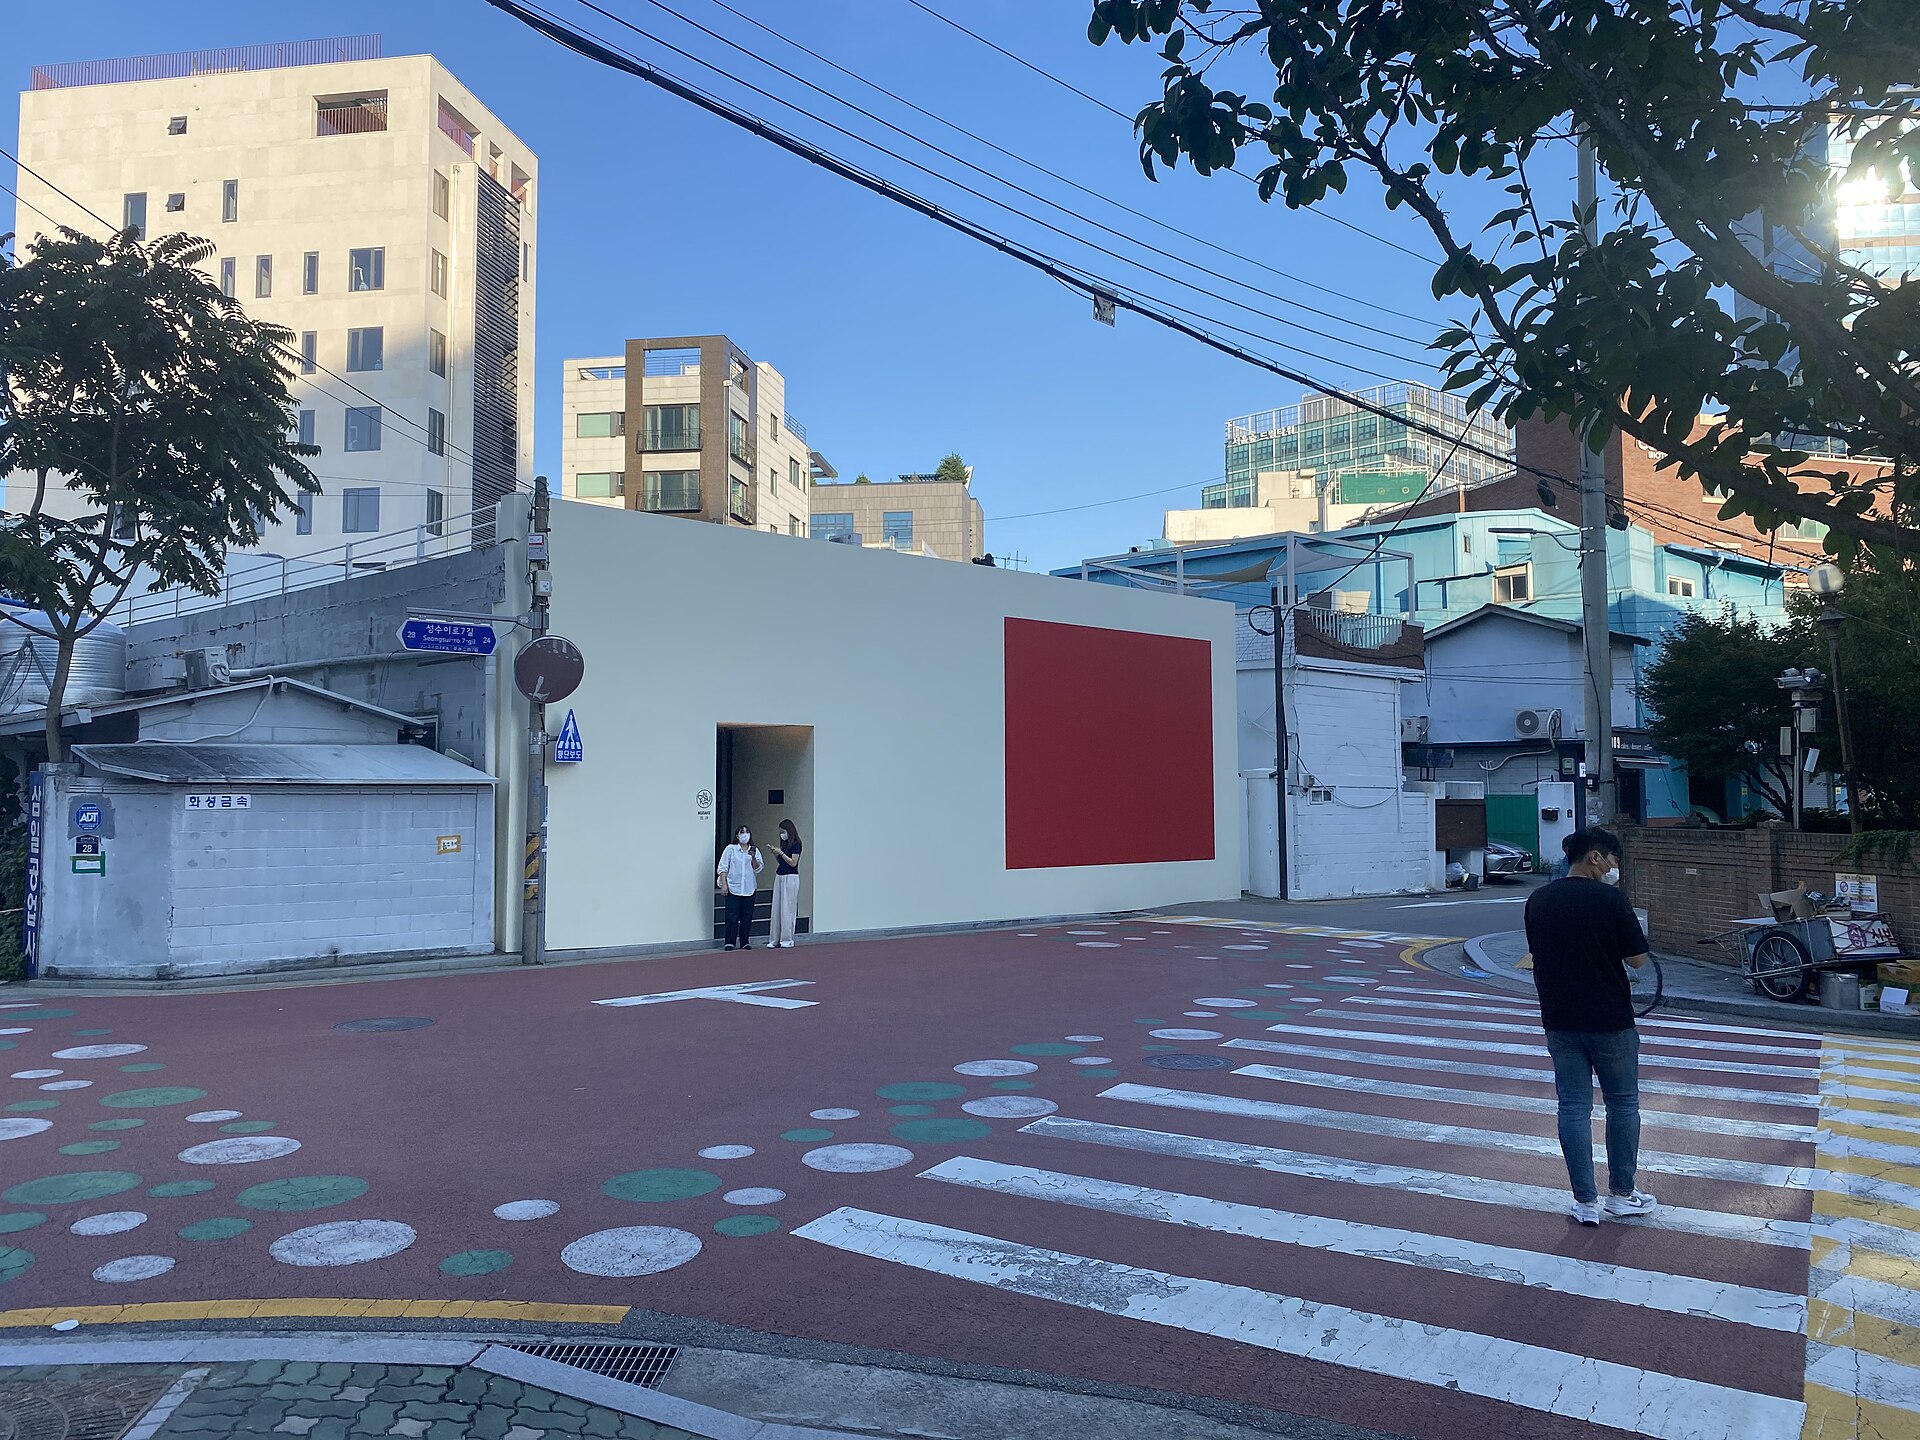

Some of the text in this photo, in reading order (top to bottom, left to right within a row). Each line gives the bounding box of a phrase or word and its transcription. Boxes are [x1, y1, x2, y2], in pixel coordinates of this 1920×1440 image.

[426, 624, 474, 637] 성수이로7길
[422, 635, 476, 645] Seongsui-ro 7-gil
[558, 750, 582, 759] 횡단보도
[189, 796, 248, 808] 화성금속
[80, 812, 98, 822] ADT
[82, 844, 93, 853] 28
[25, 785, 42, 965] 삼일공업사
